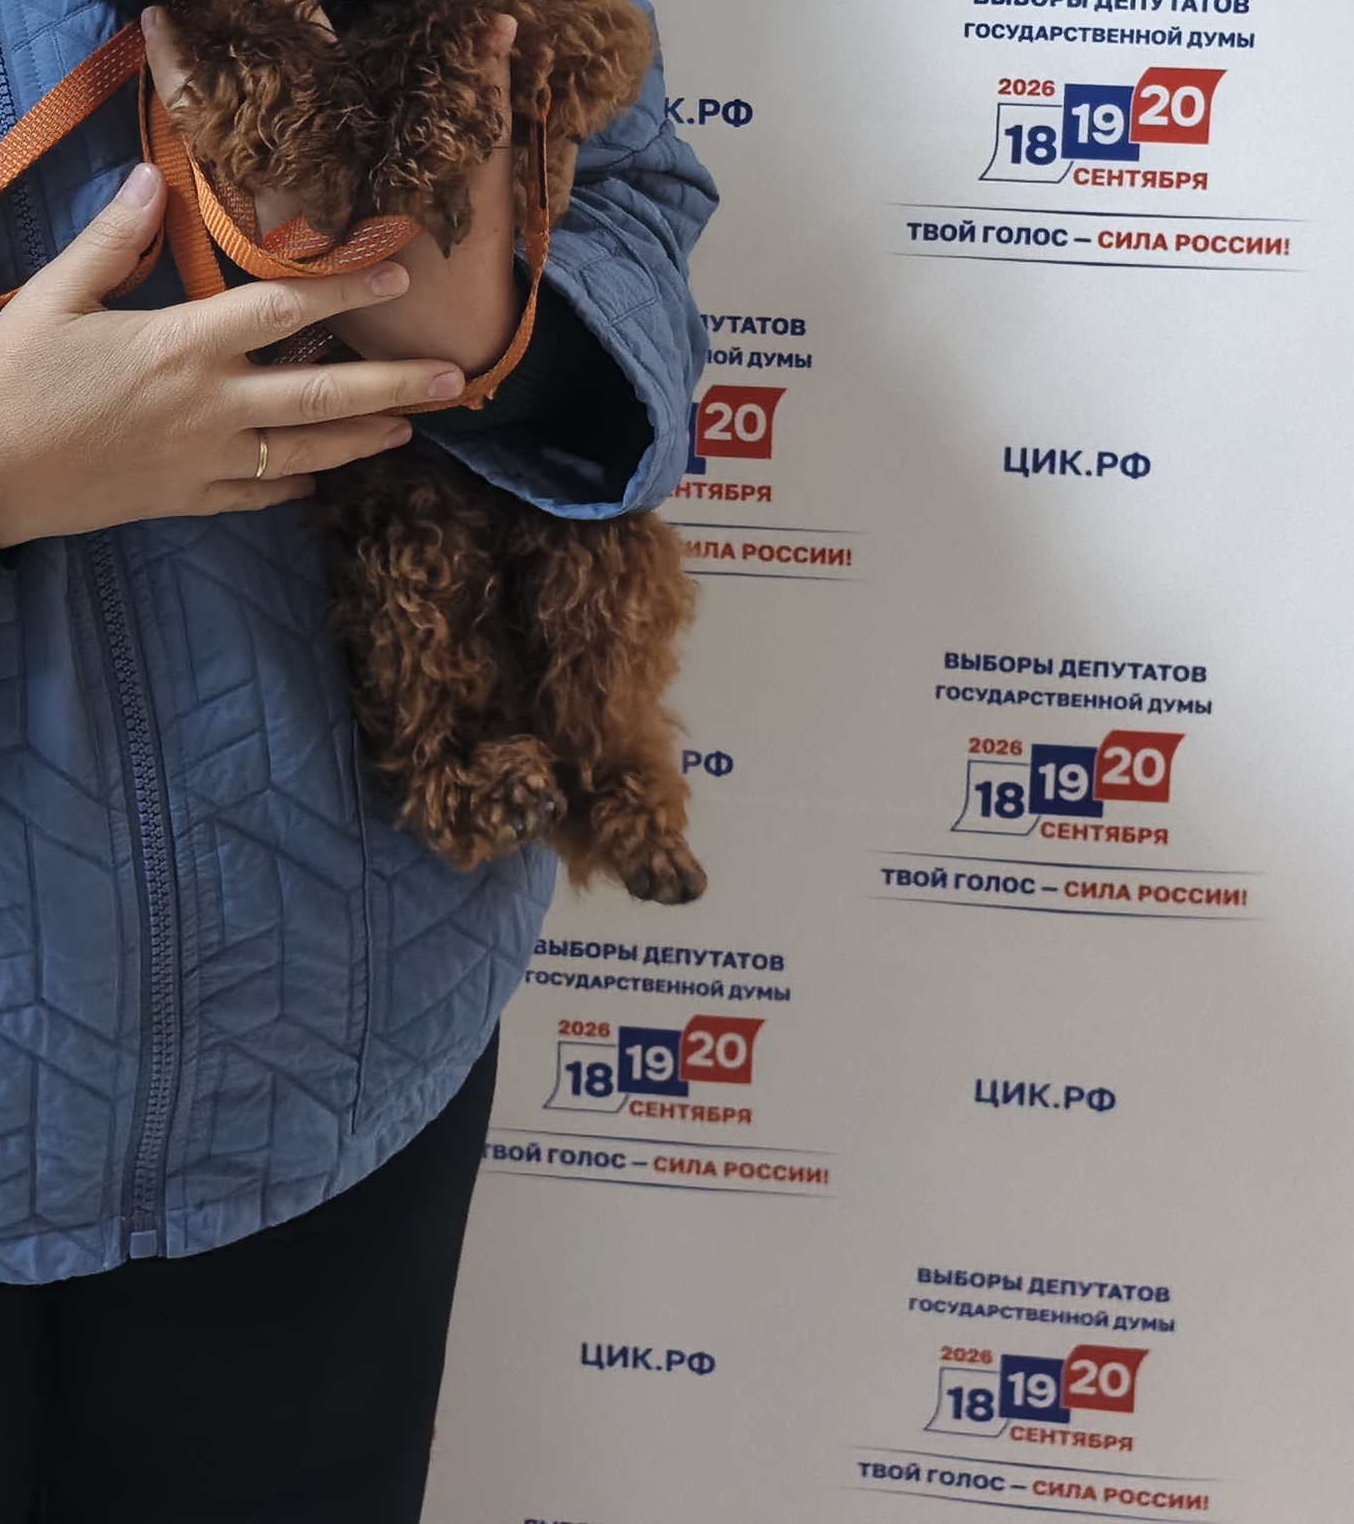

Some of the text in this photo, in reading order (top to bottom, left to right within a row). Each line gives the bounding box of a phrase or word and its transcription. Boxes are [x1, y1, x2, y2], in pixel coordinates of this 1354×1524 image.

[964, 22, 1255, 49] ГОСУДАРСТВЕННОЙ ДУМЫ
[997, 77, 1056, 97] 2026
[1138, 84, 1206, 127] 20
[1071, 103, 1125, 145] 19
[1004, 124, 1057, 166] 18
[1072, 167, 1208, 191] СЕНТЯБРЯ
[906, 219, 976, 243] ТВОЙ
[982, 225, 1068, 247] ГОЛОС
[1097, 230, 1169, 251] СИЛА
[1175, 233, 1290, 256] РОССИИ!
[746, 351, 812, 369] ДУМЫ
[703, 401, 767, 442] 20
[1003, 446, 1151, 480] ЦИК.РФ
[670, 481, 773, 503] НТЯБРЯ
[741, 543, 852, 567] РОССИИ!
[944, 651, 1207, 683] ВЫБОРЫ ДЕПУТАТОВ
[935, 684, 1213, 715] ГОСУДАРСТВЕННОЙ ДУМЫ
[968, 737, 1023, 756] 2026
[1038, 762, 1089, 802] 19
[1102, 746, 1166, 787] 20
[974, 780, 1025, 820] 18
[1039, 821, 1169, 845] СЕНТЯБРЯ
[881, 867, 949, 889] ТВОЙ
[953, 873, 1036, 895] ГОЛОС
[1064, 880, 1132, 901] СИЛА
[1137, 884, 1247, 906] РОССИИ!
[534, 938, 785, 972] ВЫБОРЫ ДЕПУТАТОВ
[525, 969, 791, 1002] ГОСУДАРСТВЕННОЙ ДУМЫ
[558, 1019, 611, 1038] 2026
[625, 1044, 674, 1082] 19
[686, 1030, 747, 1069] 20
[565, 1061, 614, 1098] 18
[974, 1078, 1116, 1113] ЦИК.РФ
[628, 1100, 752, 1125] СЕНТЯБРЯ
[547, 1147, 626, 1170] ГОЛОС
[652, 1155, 718, 1177] СИЛА
[723, 1161, 829, 1184] РОССИИ!
[917, 1267, 1171, 1303] ВЫБОРЫ ДЕПУТАТОВ
[908, 1296, 1175, 1333] ГОСУДАРСТВЕННОЙ ДУМЫ
[580, 1342, 716, 1376] ЦИК.РФ
[940, 1345, 993, 1365] 2026
[1007, 1371, 1057, 1409] 19
[1069, 1359, 1131, 1398] 20
[946, 1386, 995, 1423] 18
[1008, 1425, 1134, 1452] СЕНТЯБРЯ
[858, 1462, 921, 1482] ТВОЙ
[926, 1468, 1005, 1492] ГОЛОС
[1032, 1480, 1097, 1501] СИЛА
[1103, 1487, 1209, 1511] РОССИИ!
